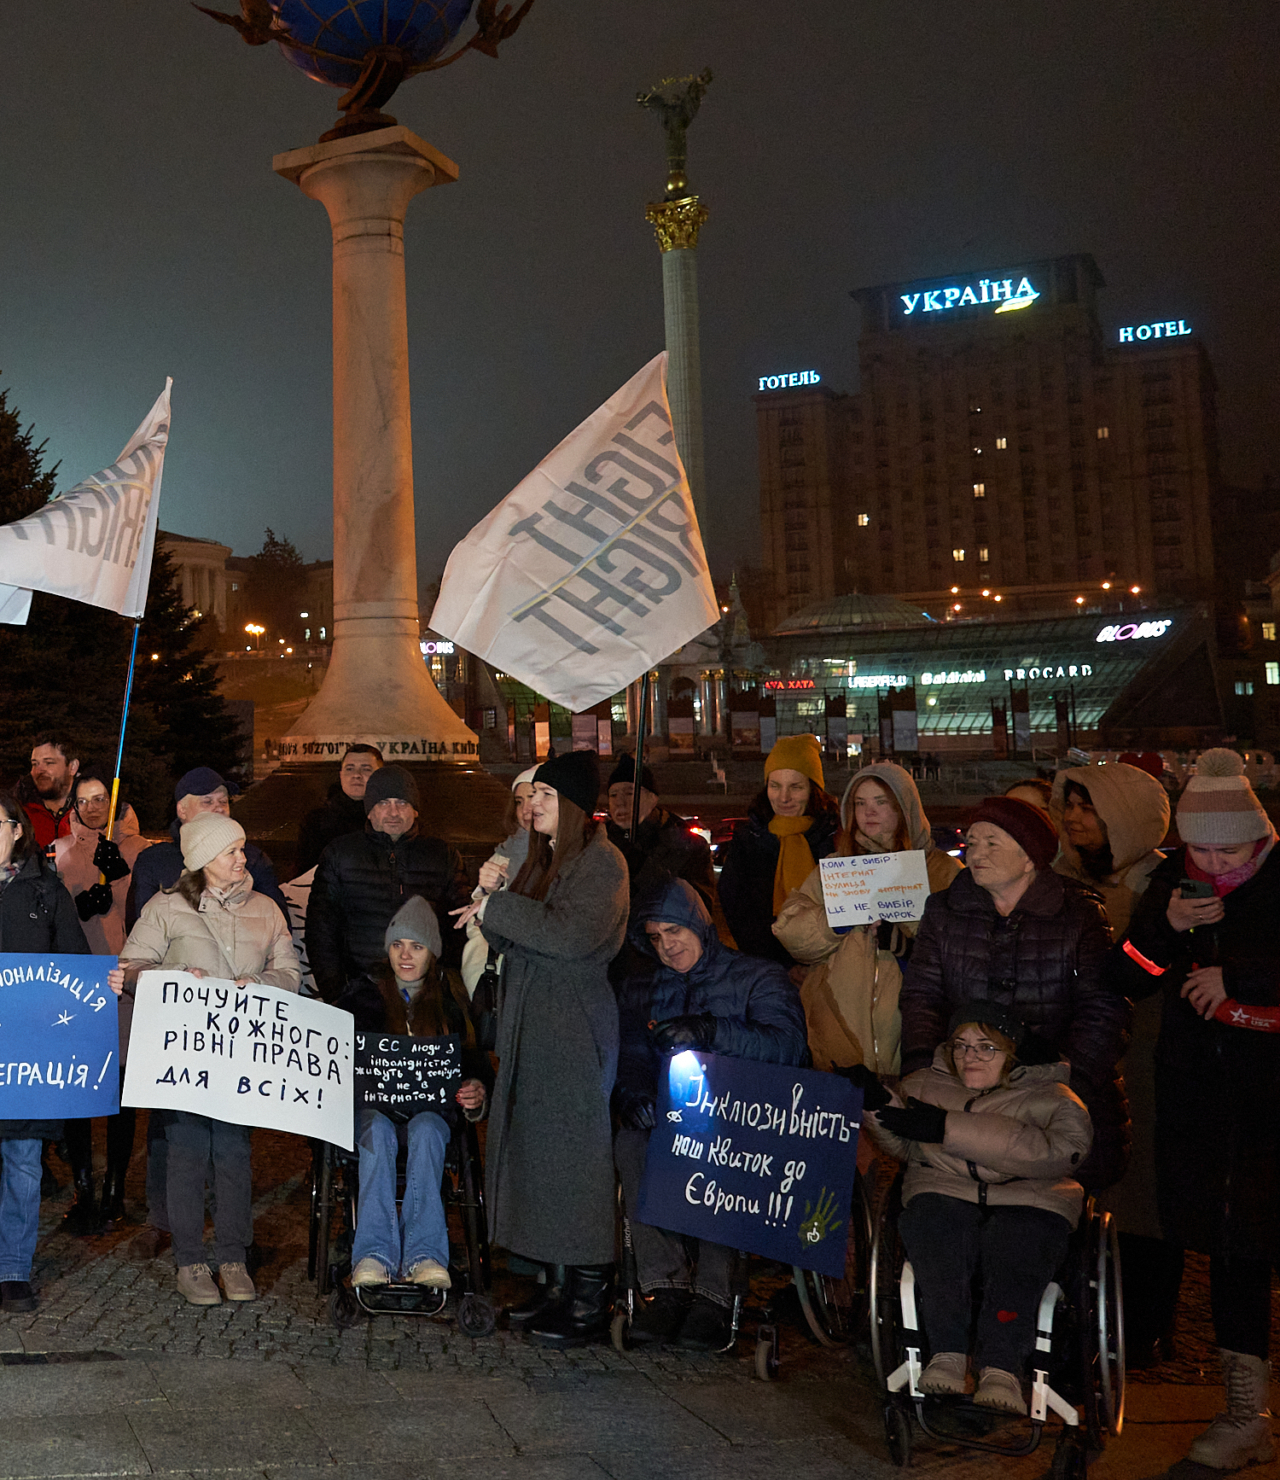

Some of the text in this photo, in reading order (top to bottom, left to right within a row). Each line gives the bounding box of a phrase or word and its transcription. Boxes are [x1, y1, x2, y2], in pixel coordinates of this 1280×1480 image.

[900, 275, 1038, 315] УКРАЇНА
[1119, 319, 1191, 343] HOTEL
[758, 369, 821, 391] ГОТЕЛЬ
[1096, 620, 1172, 642] GLOBUS
[376, 739, 448, 755] УКРАЇНА
[822, 861, 845, 870] КОЛИ
[854, 902, 870, 911] НЕ
[163, 1023, 342, 1085] РІВНІ ПРАВА
[356, 1035, 366, 1051] У
[378, 1038, 400, 1052] ЄС
[411, 1042, 440, 1056] люди
[396, 1081, 411, 1090] не
[672, 1133, 704, 1160] наш
[780, 1160, 807, 1194] до
